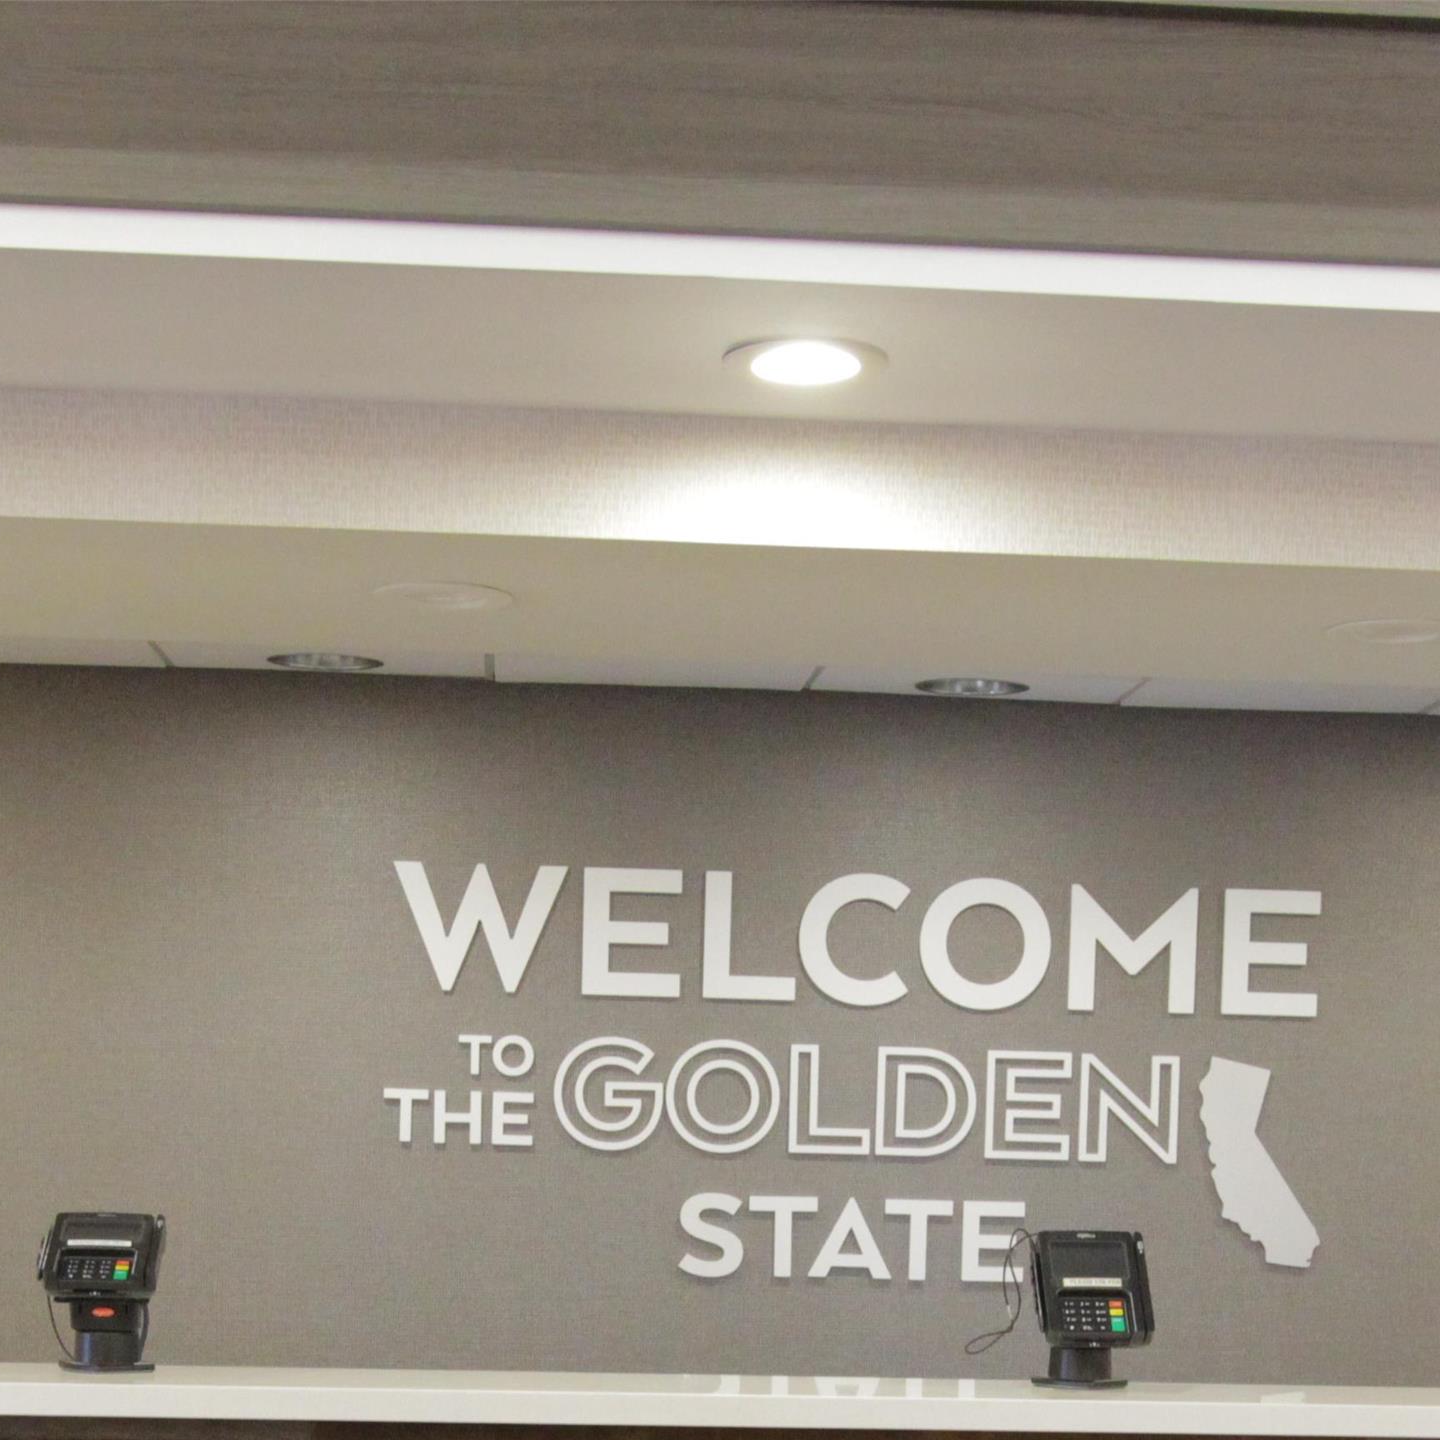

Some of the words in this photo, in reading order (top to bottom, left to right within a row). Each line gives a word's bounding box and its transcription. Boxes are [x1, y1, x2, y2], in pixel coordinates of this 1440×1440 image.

[392, 860, 1322, 1018] WELCOME
[458, 1033, 535, 1077] TO
[553, 1036, 1180, 1164] GOLDEN
[383, 1087, 535, 1147] THE
[677, 1192, 1027, 1283] STATE
